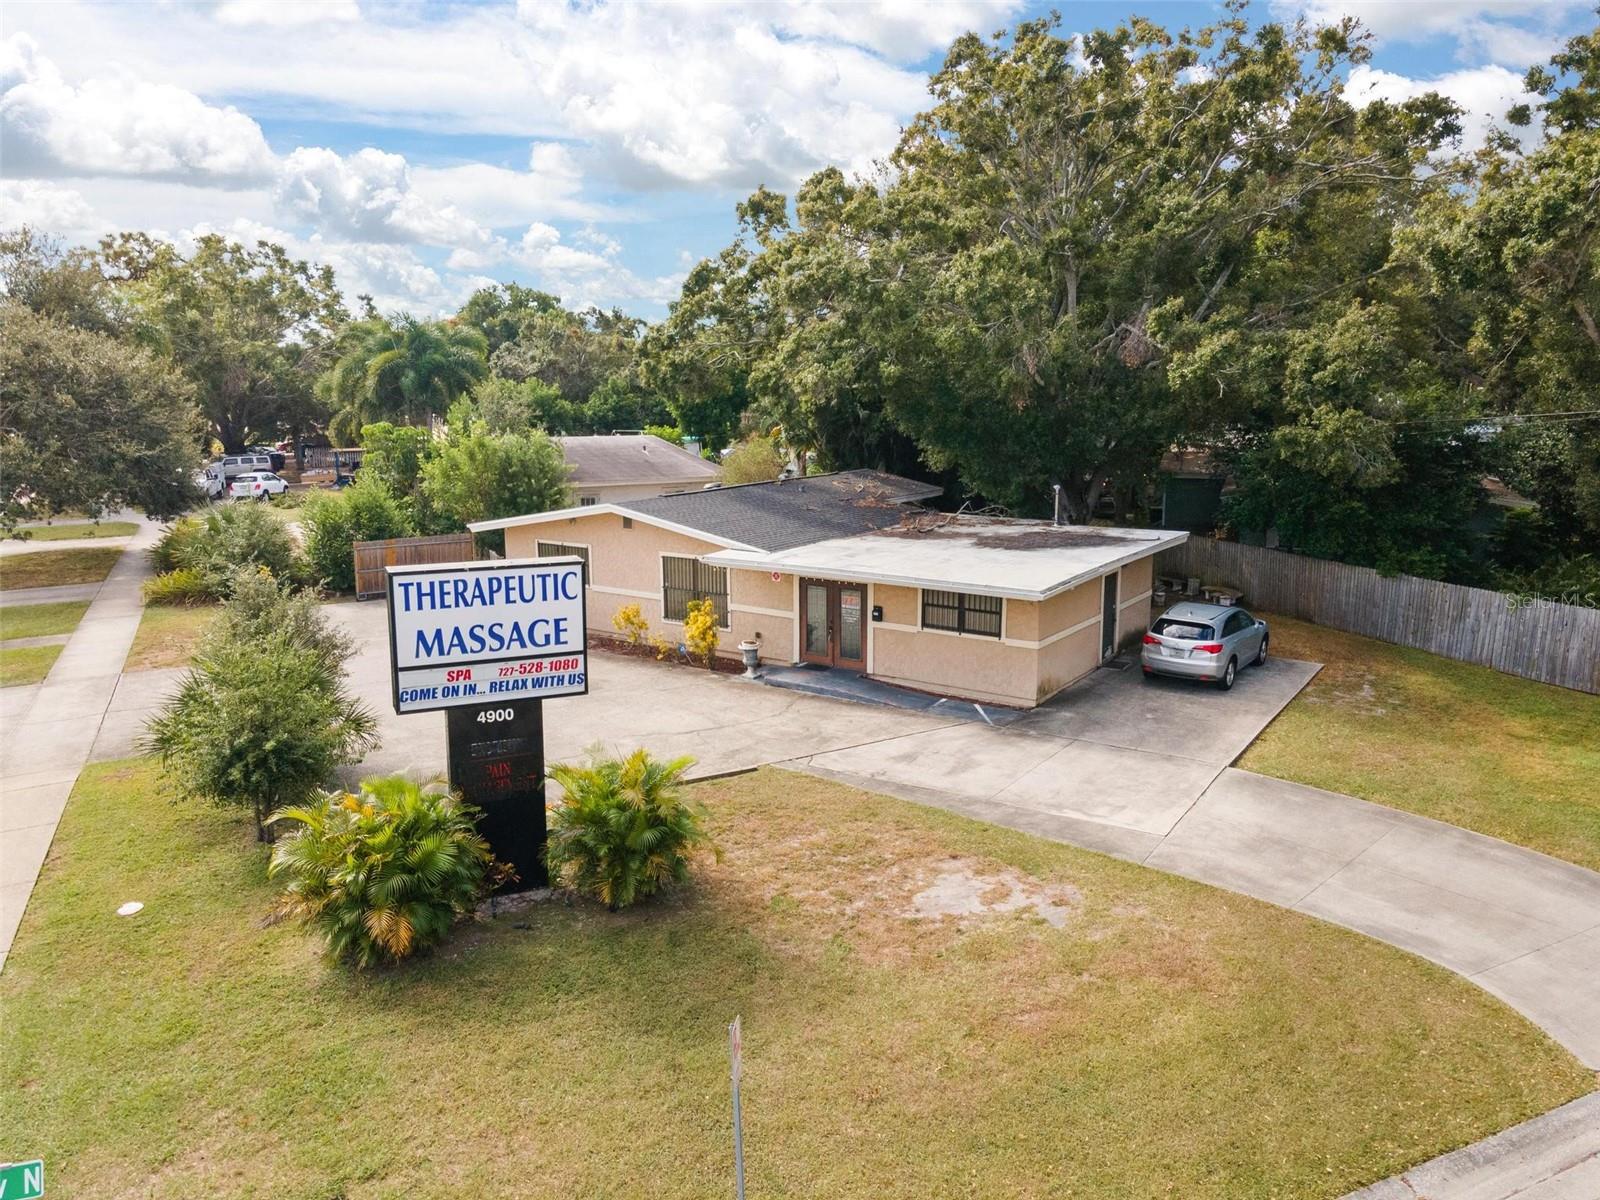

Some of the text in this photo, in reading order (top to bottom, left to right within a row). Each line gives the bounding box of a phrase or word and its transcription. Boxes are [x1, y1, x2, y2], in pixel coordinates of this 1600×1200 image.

[398, 571, 578, 612] THERAPEUTIC
[415, 617, 568, 659] MASSAGE
[447, 669, 472, 683] SPA
[498, 658, 579, 677] 727-528-1080
[400, 672, 585, 703] COME ON IN... RELAX WITH US
[477, 708, 515, 723] 4900
[24, 1166, 40, 1194] N
